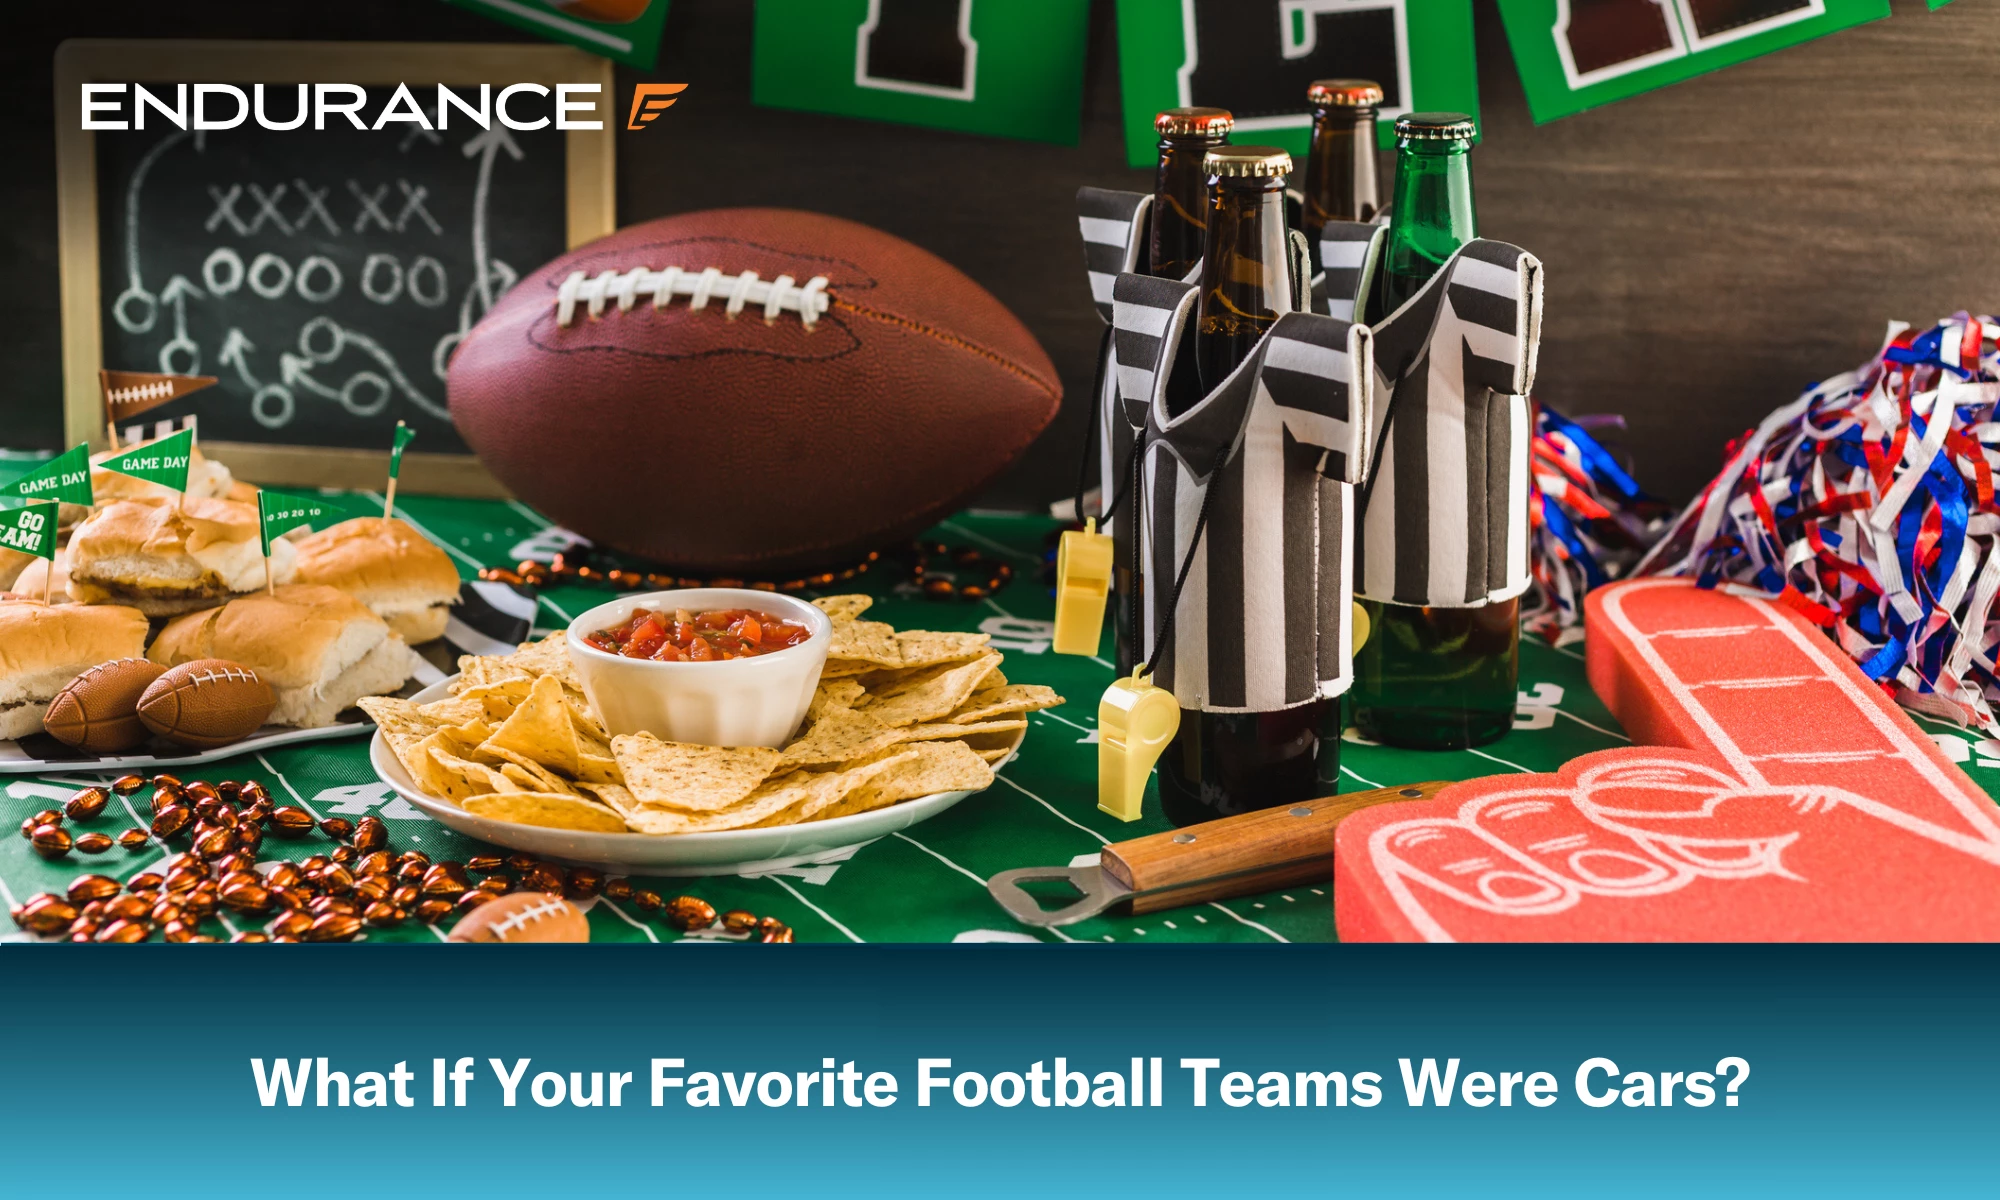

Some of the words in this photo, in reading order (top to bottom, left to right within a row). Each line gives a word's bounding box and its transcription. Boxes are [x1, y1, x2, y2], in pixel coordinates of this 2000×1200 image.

[122, 457, 160, 471] GAME
[163, 456, 188, 469] DAY
[19, 476, 59, 495] GAME
[61, 470, 87, 487] DAY
[17, 510, 45, 532] GO
[277, 511, 289, 520] 30
[291, 509, 305, 518] 20
[309, 508, 321, 516] 10
